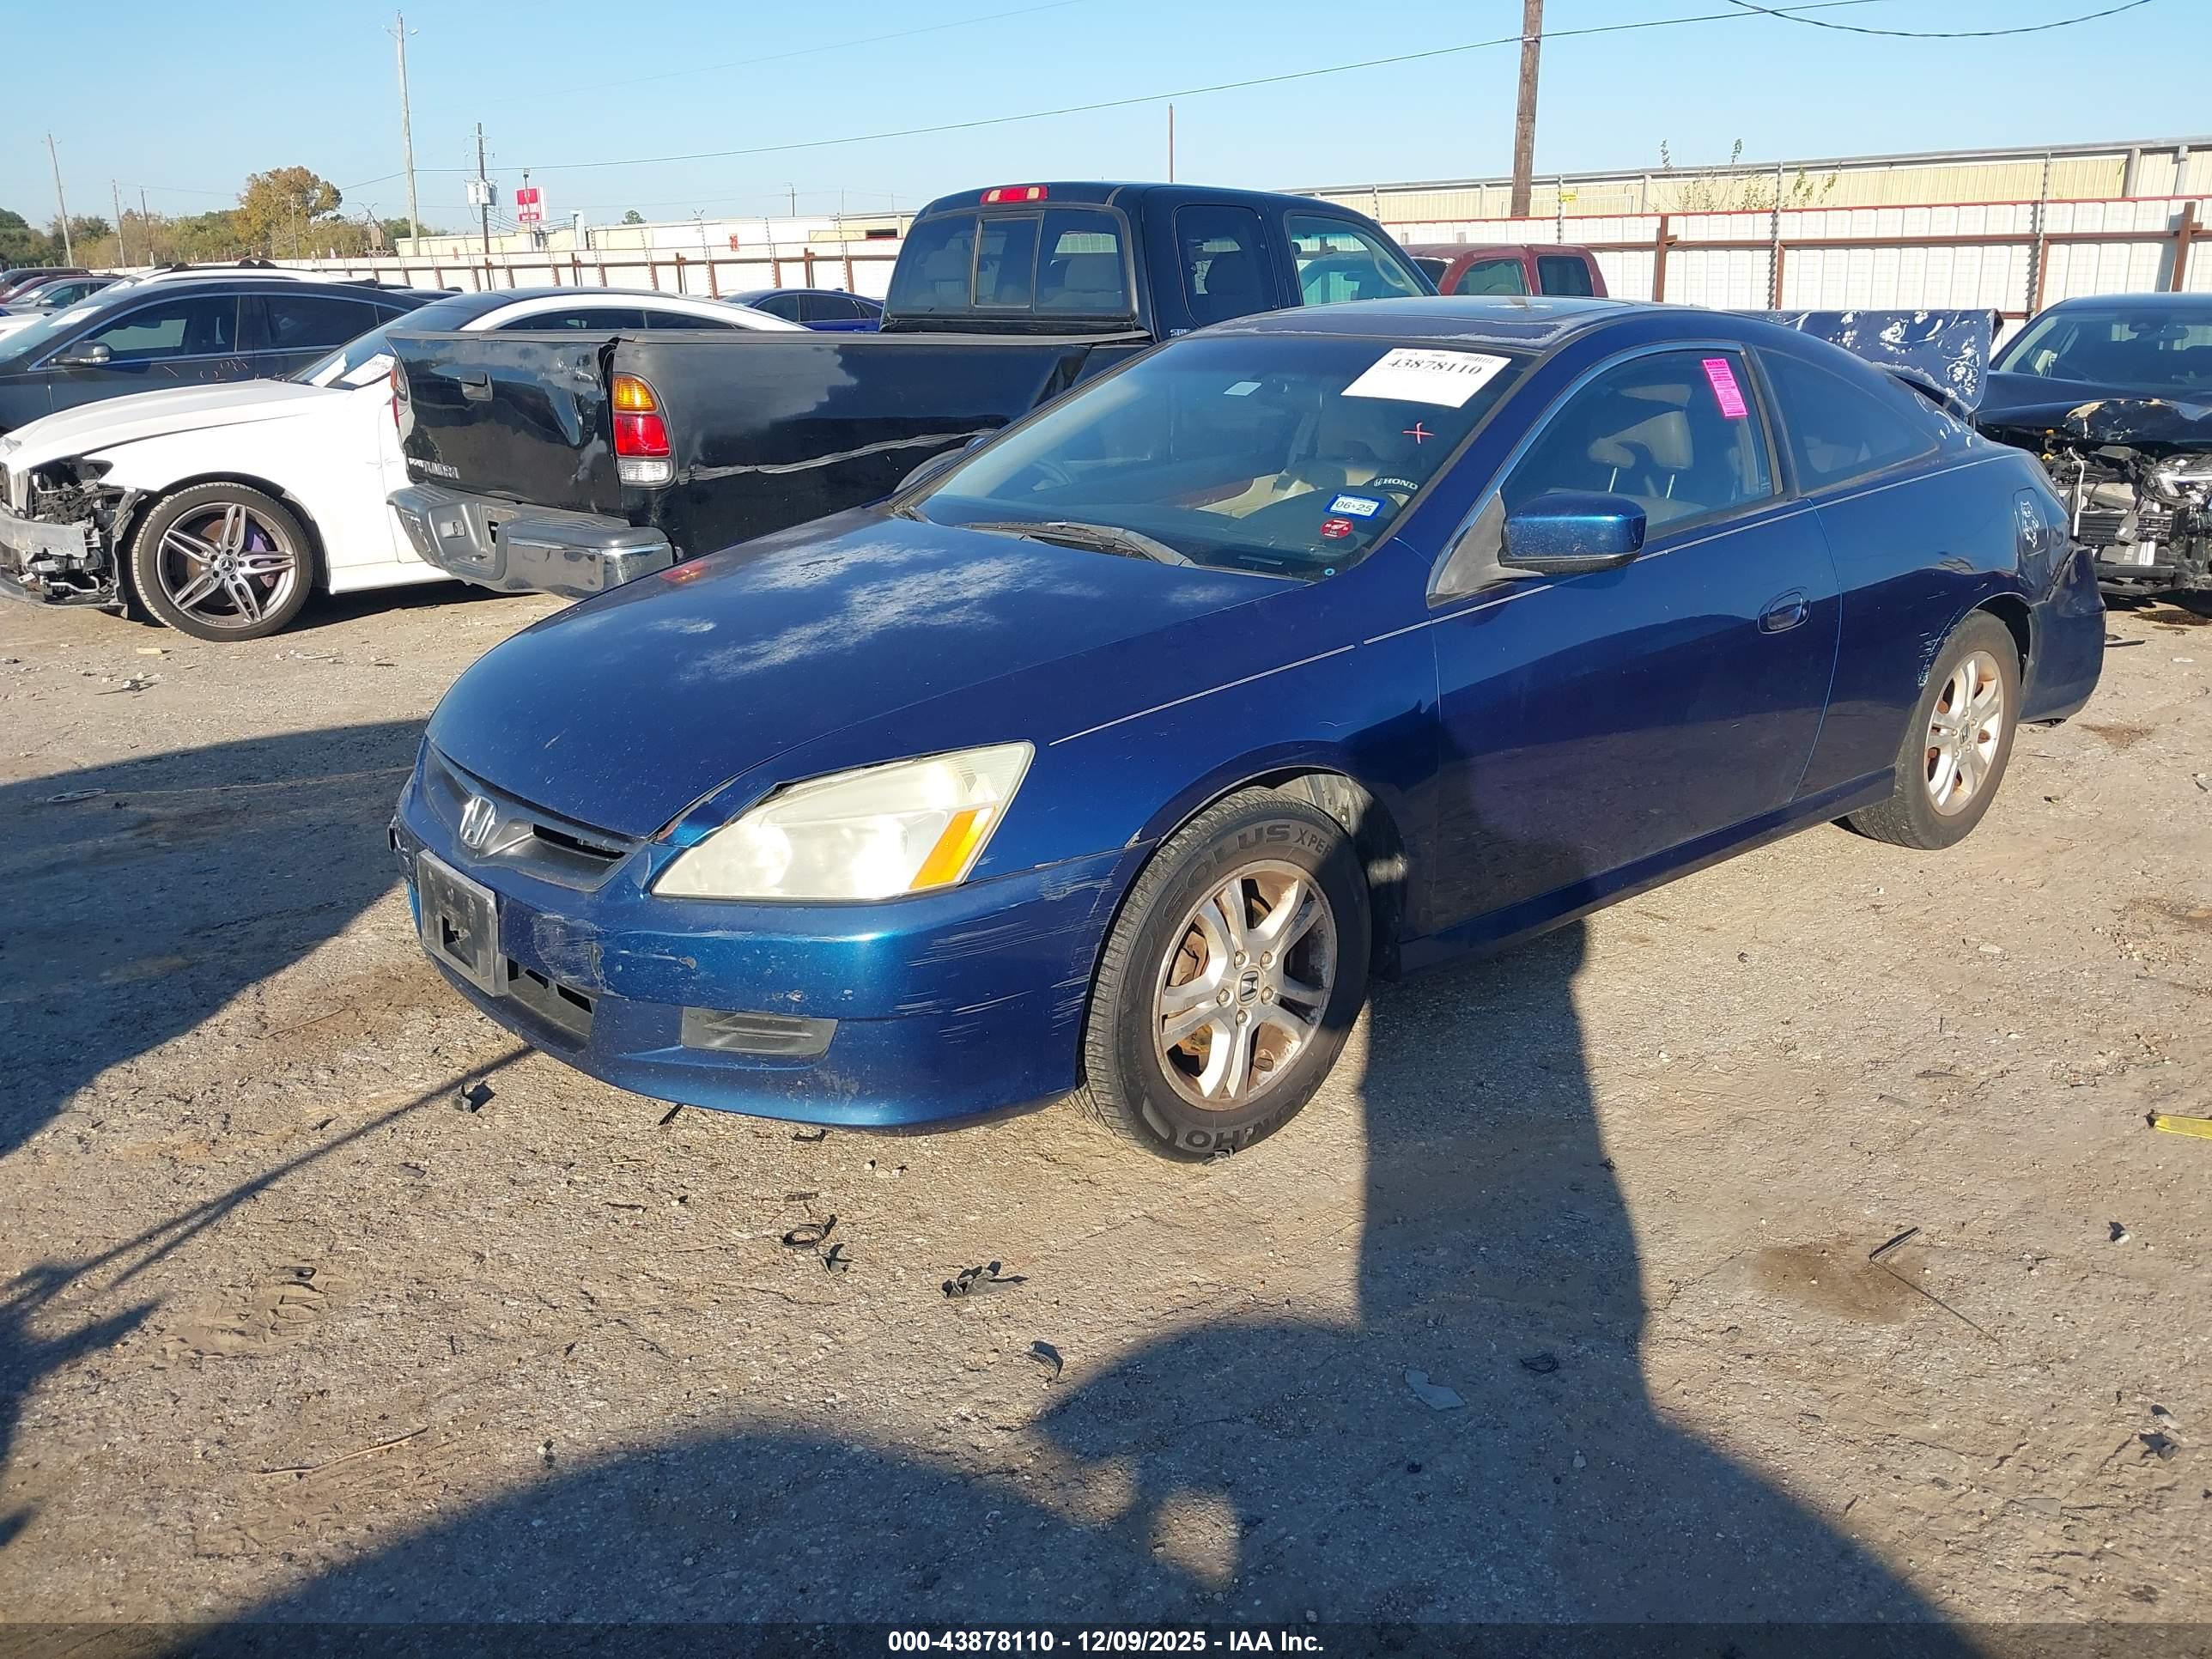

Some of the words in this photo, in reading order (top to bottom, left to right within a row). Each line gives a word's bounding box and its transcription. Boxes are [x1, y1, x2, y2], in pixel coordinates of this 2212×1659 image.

[1387, 358, 1482, 375] 43878110
[1382, 477, 1419, 489] HOND
[1292, 828, 1334, 858] XPER
